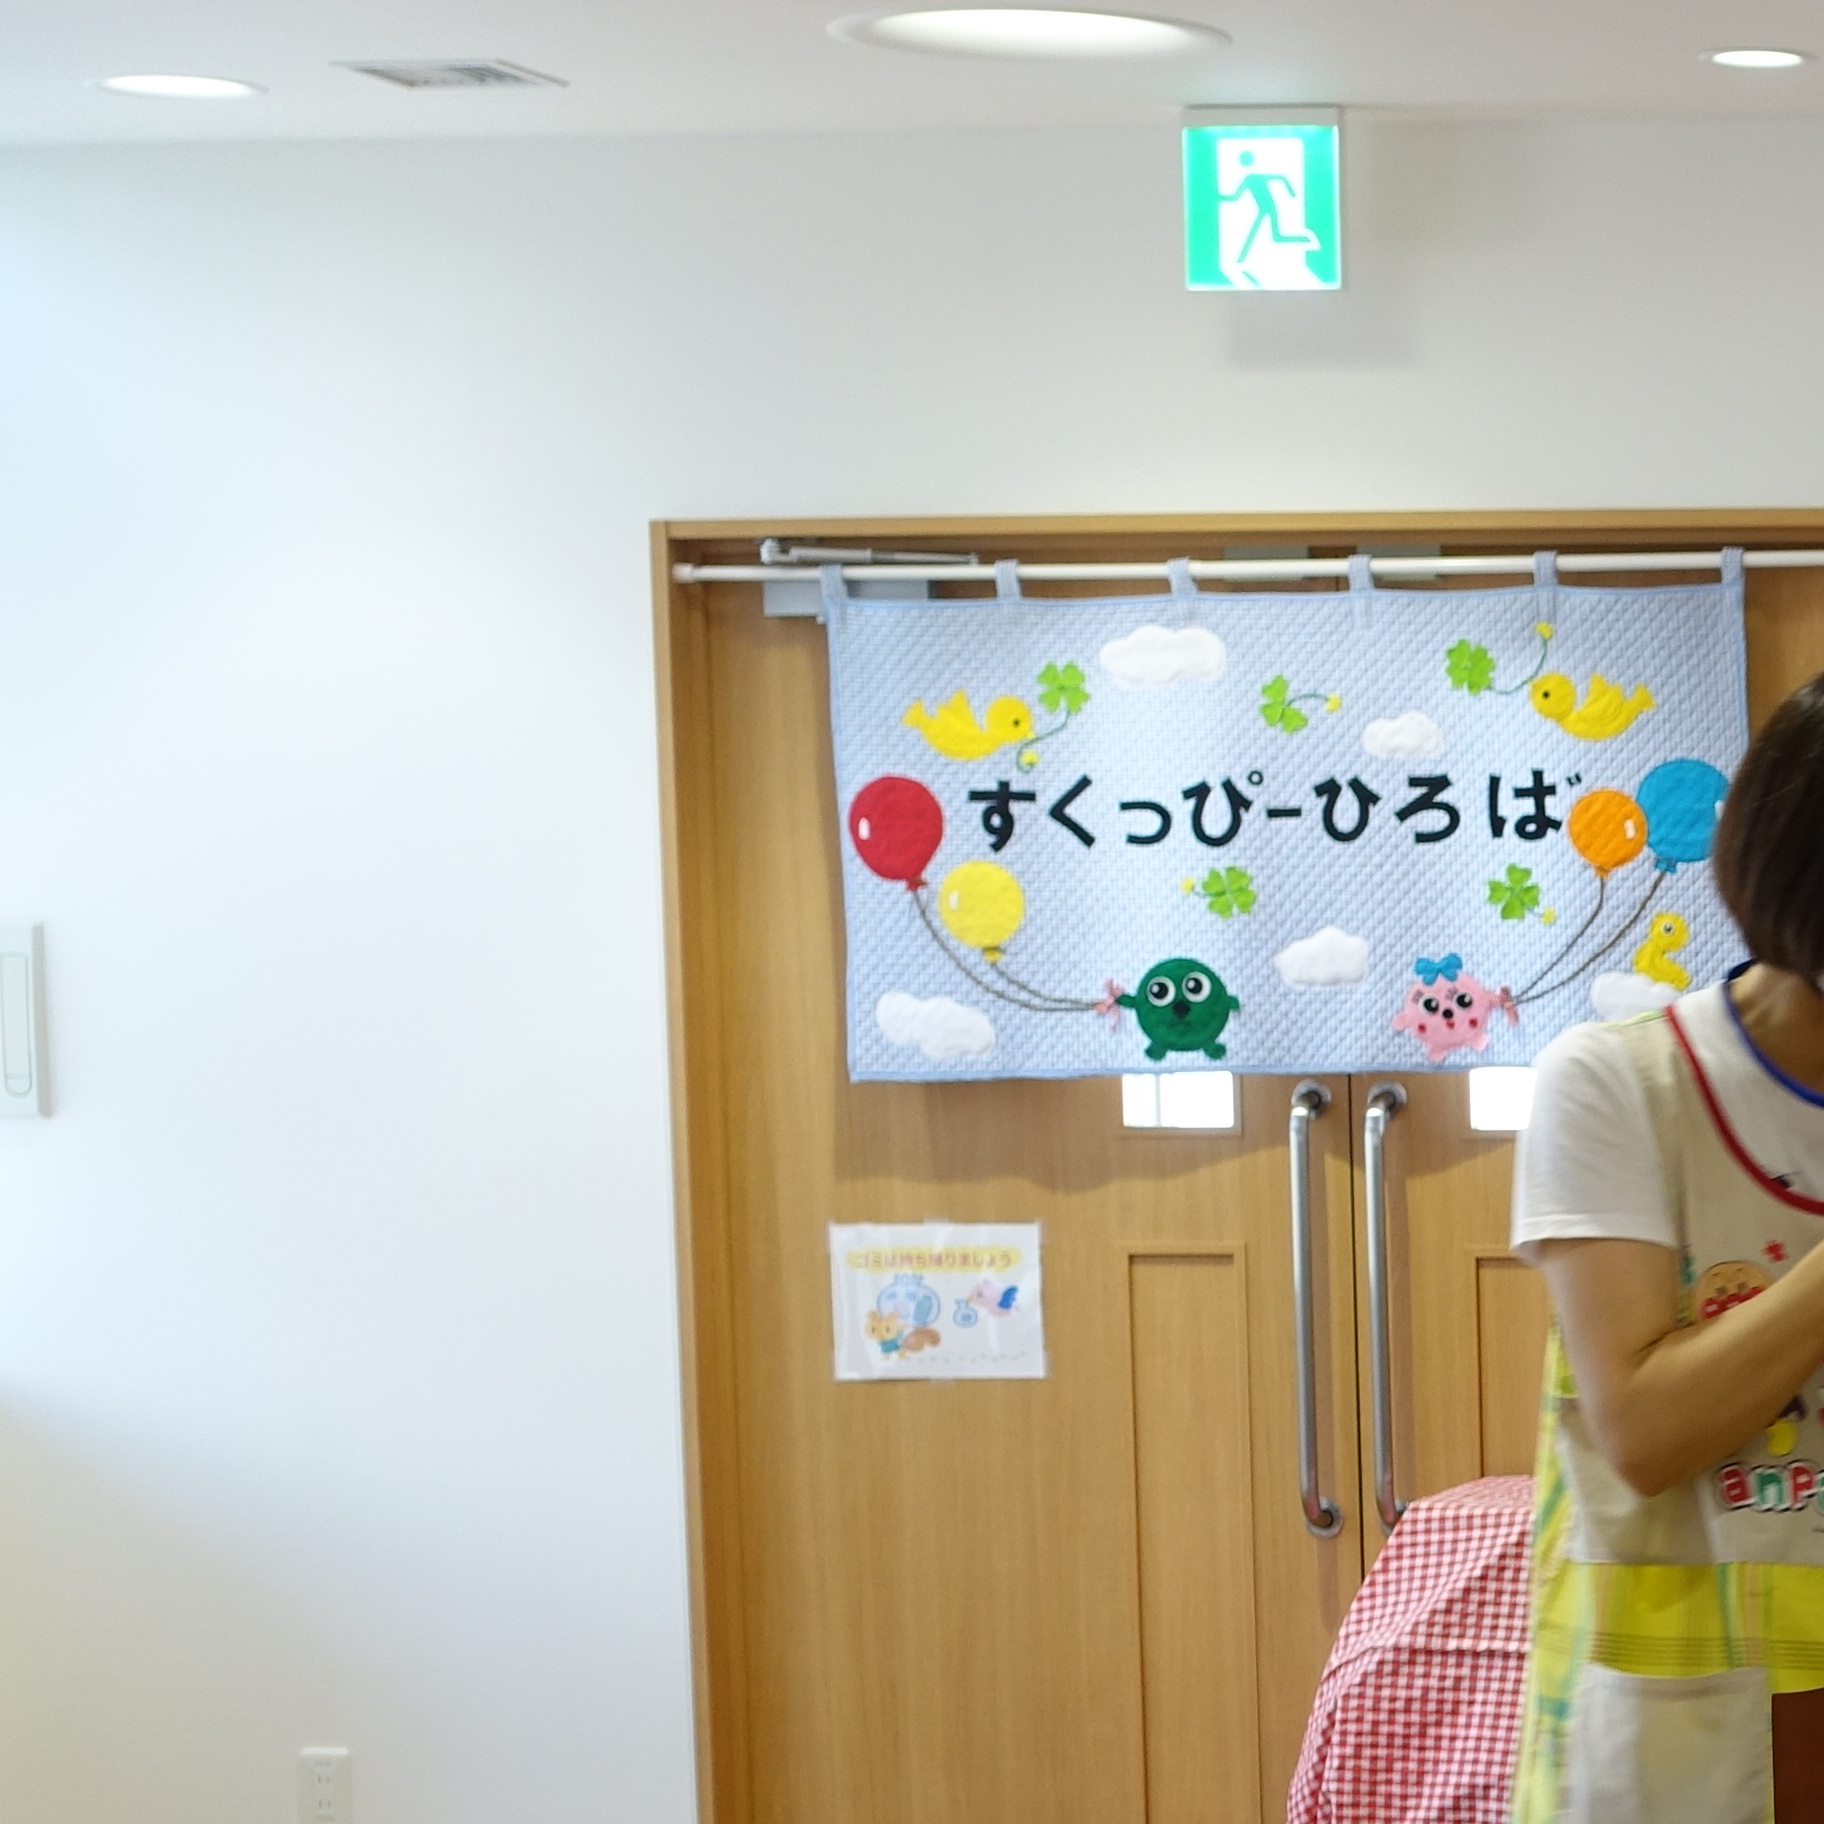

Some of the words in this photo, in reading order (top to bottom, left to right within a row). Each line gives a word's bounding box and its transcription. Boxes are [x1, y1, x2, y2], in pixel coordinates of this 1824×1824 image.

[967, 769, 1582, 852] すくっぴーひろば
[857, 1252, 1013, 1268] ゴミは持ち帰りましょう
